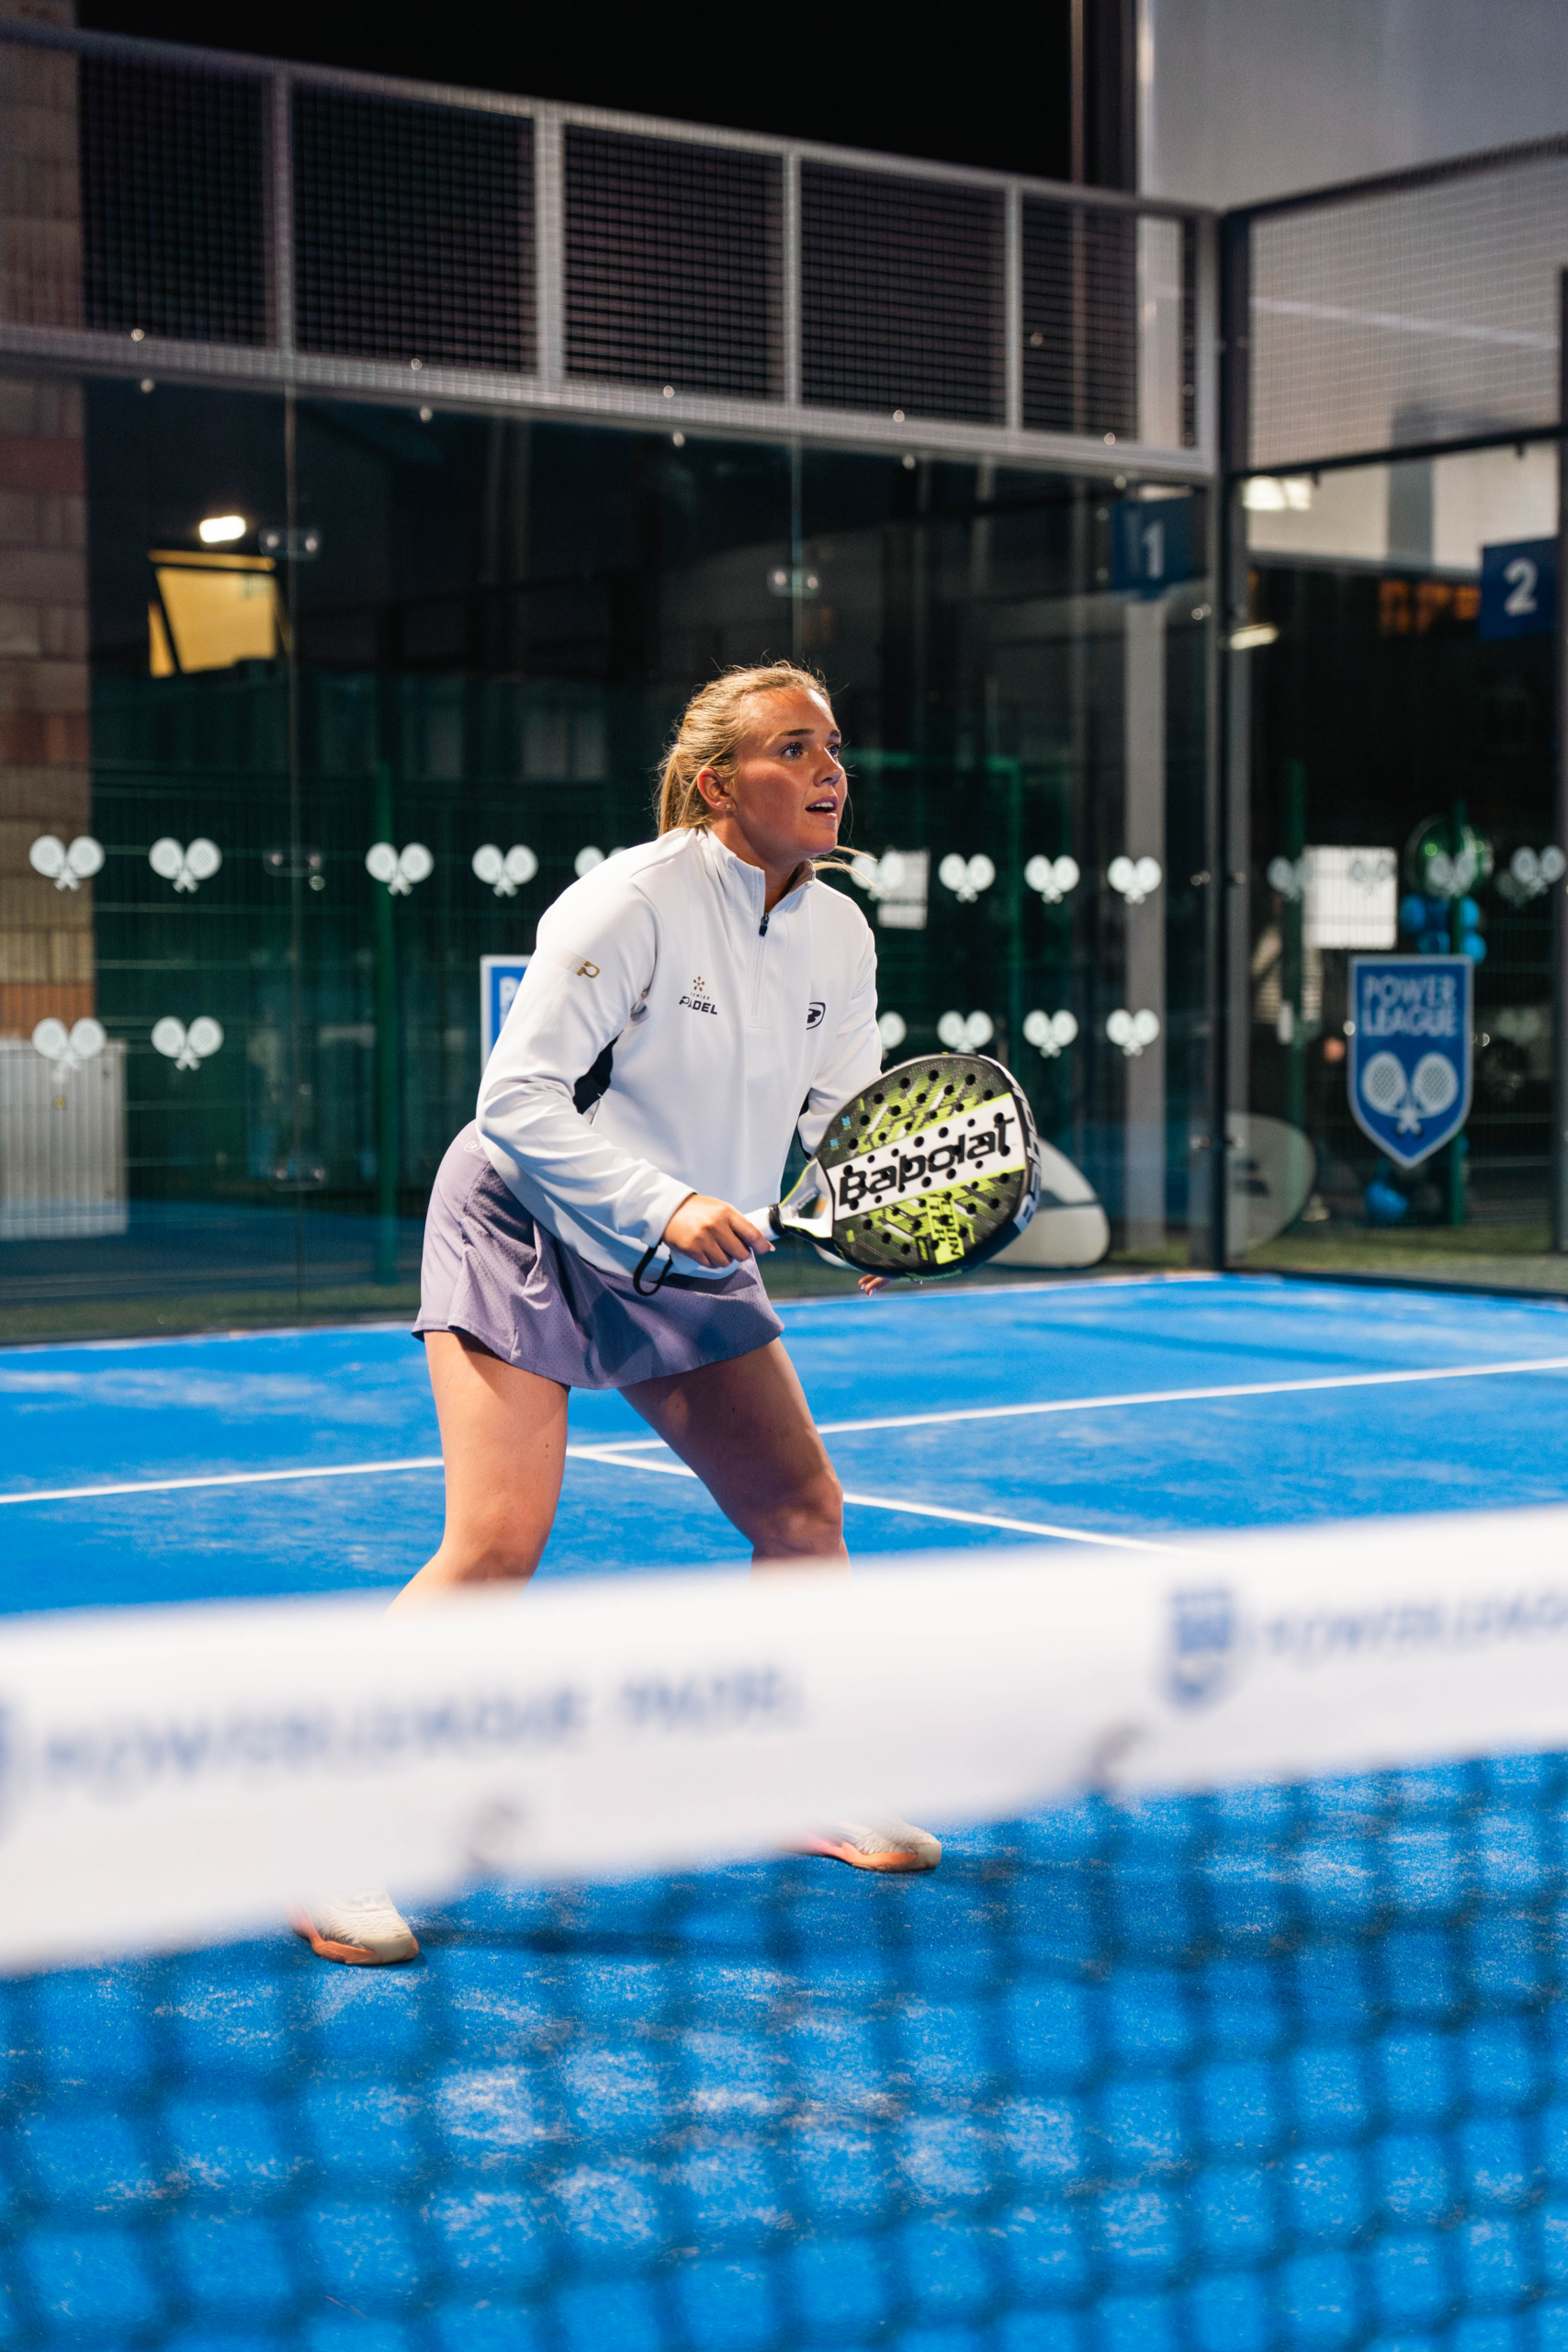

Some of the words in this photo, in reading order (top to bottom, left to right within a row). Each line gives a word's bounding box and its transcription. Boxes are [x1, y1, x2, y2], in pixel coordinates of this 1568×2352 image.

[1141, 522, 1165, 580] 1
[1504, 557, 1540, 617] 2
[838, 1115, 1015, 1206] Babolat
